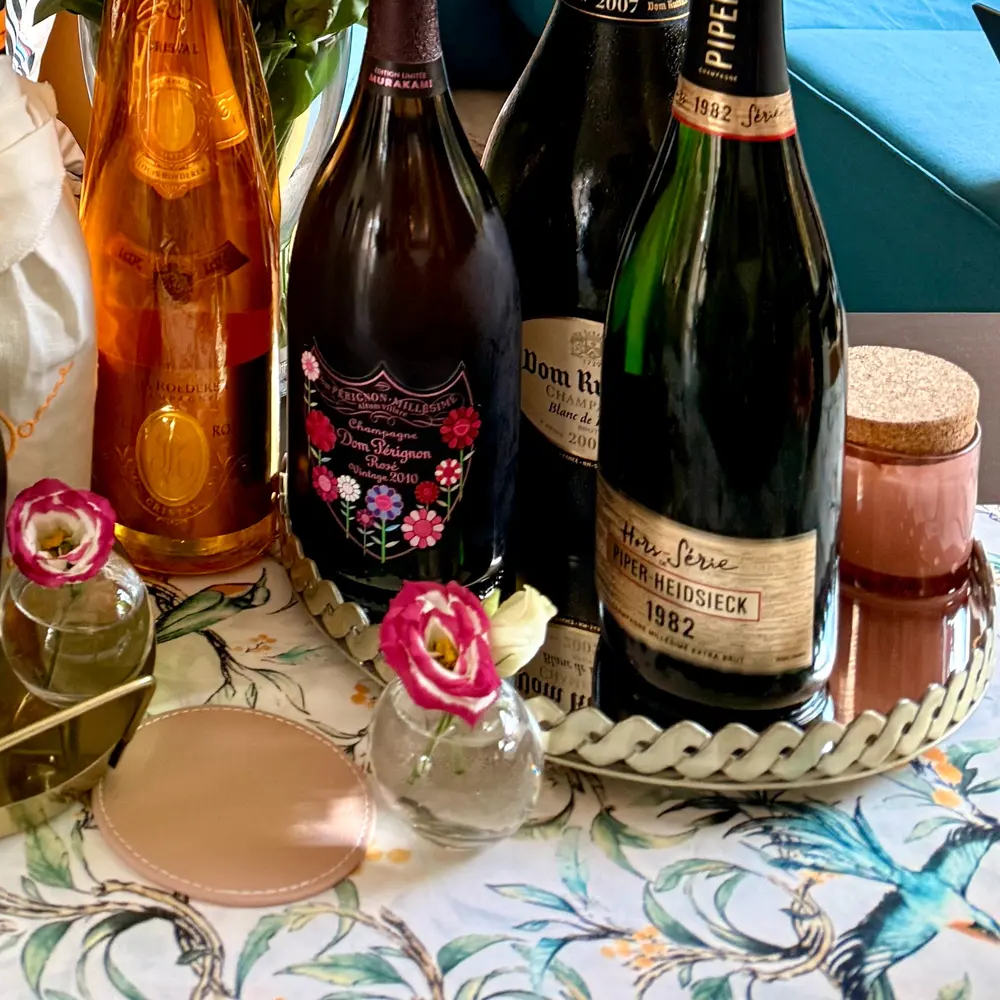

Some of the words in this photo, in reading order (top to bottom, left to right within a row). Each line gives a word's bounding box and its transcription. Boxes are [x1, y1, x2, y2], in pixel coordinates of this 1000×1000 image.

[368, 73, 433, 90] MURAKAMI
[694, 96, 733, 123] 1982
[522, 348, 571, 389] Dom
[545, 384, 601, 412] CHAMP
[548, 401, 578, 422] Blanc
[579, 412, 593, 426] de
[348, 417, 419, 442] Champagne
[568, 431, 597, 451] 200
[336, 427, 370, 452] Dom
[370, 437, 432, 464] Pérignon
[348, 462, 389, 484] Vintage
[389, 471, 419, 484] 2010
[365, 454, 400, 472] Rosé
[645, 599, 696, 640] 1982
[691, 648, 720, 661] EXTRA
[722, 653, 746, 665] BRUT
